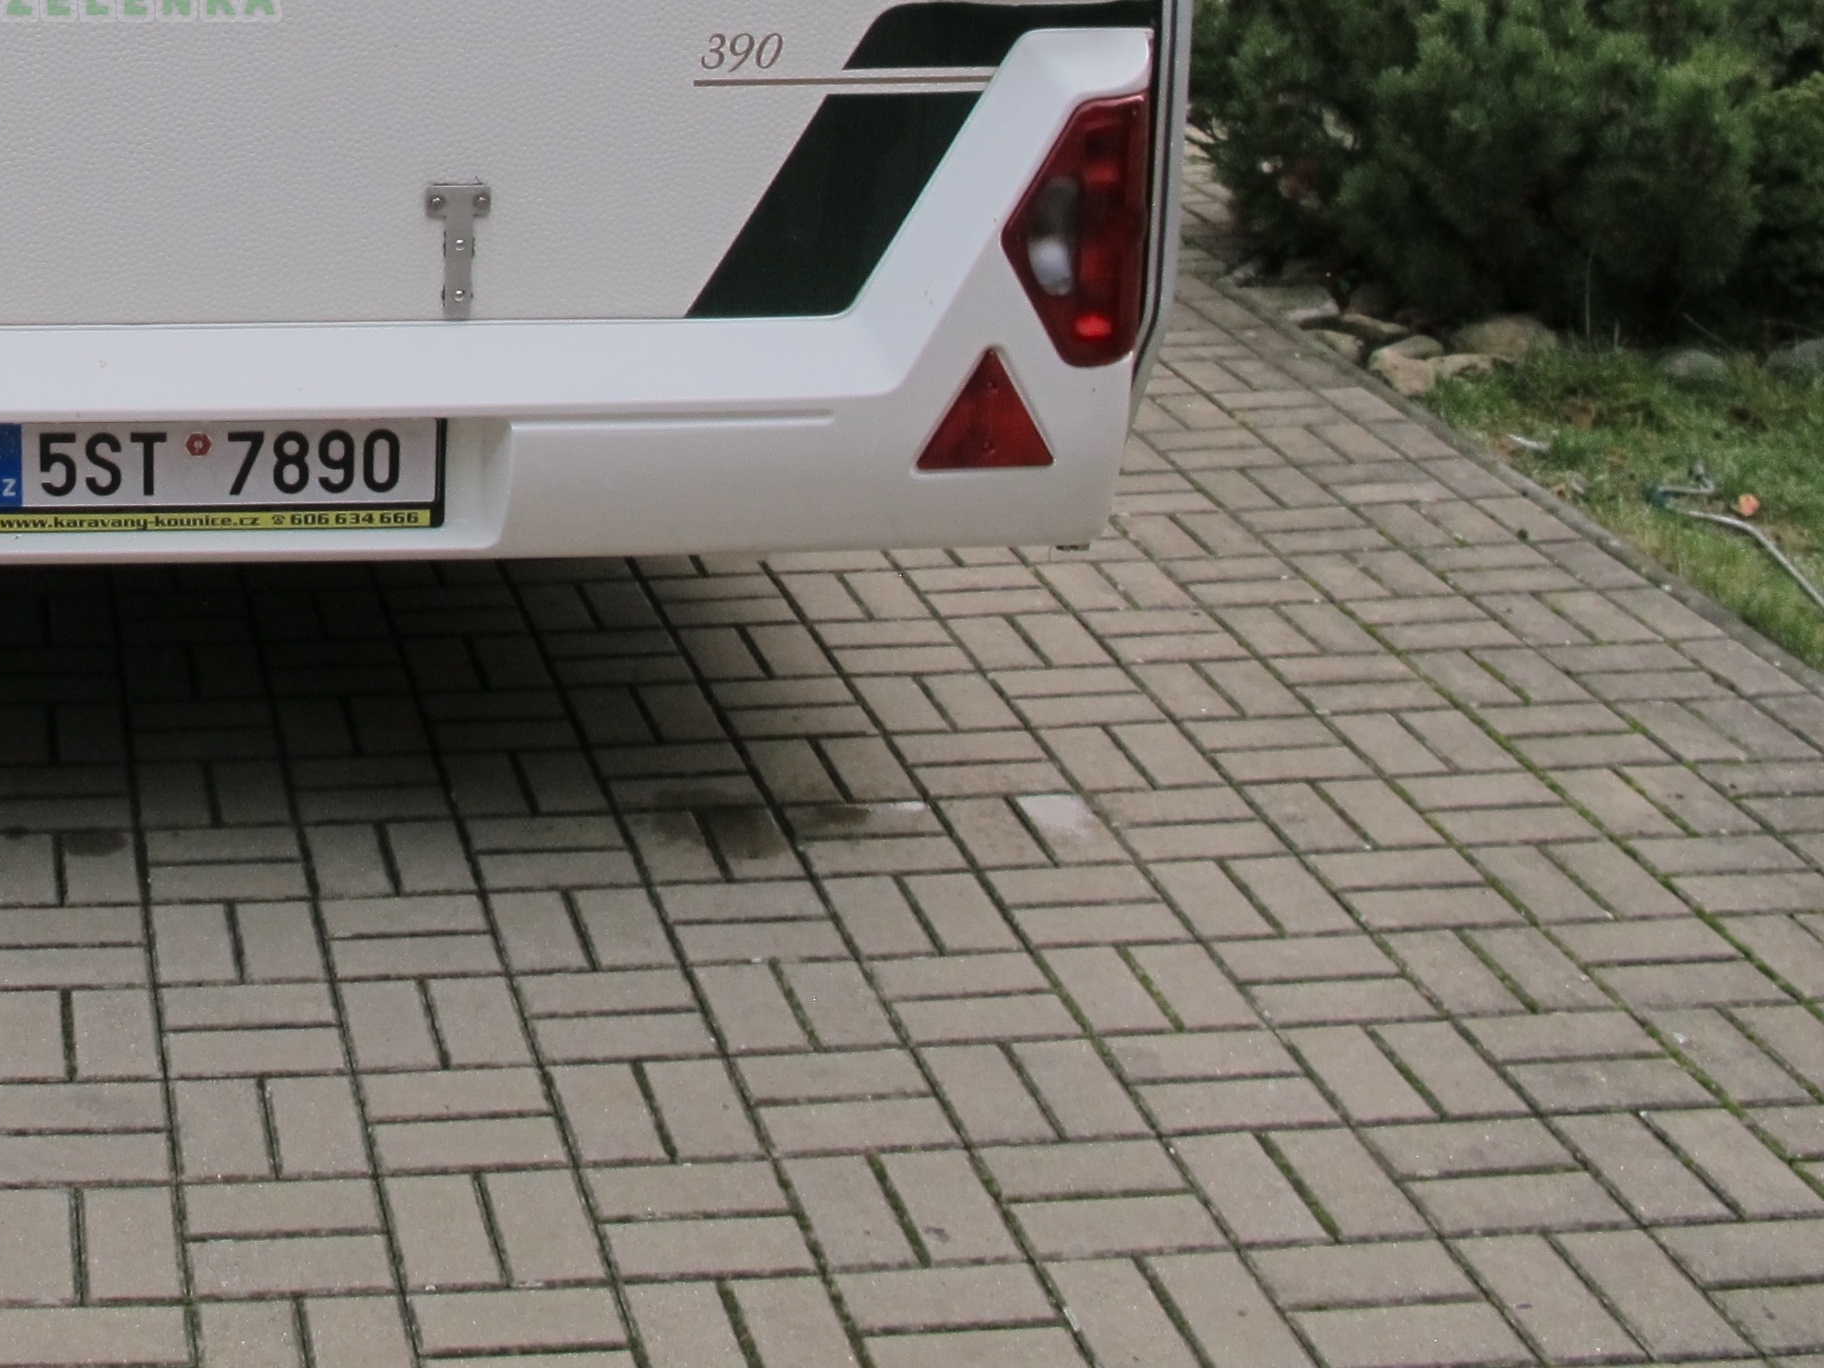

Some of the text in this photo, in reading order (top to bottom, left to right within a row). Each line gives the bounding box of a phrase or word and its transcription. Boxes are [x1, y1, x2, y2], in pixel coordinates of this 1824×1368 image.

[700, 32, 784, 73] 390
[37, 429, 401, 497] 5ST 7890
[0, 511, 420, 530] www.karavany-kounice.cz 606 634 666
